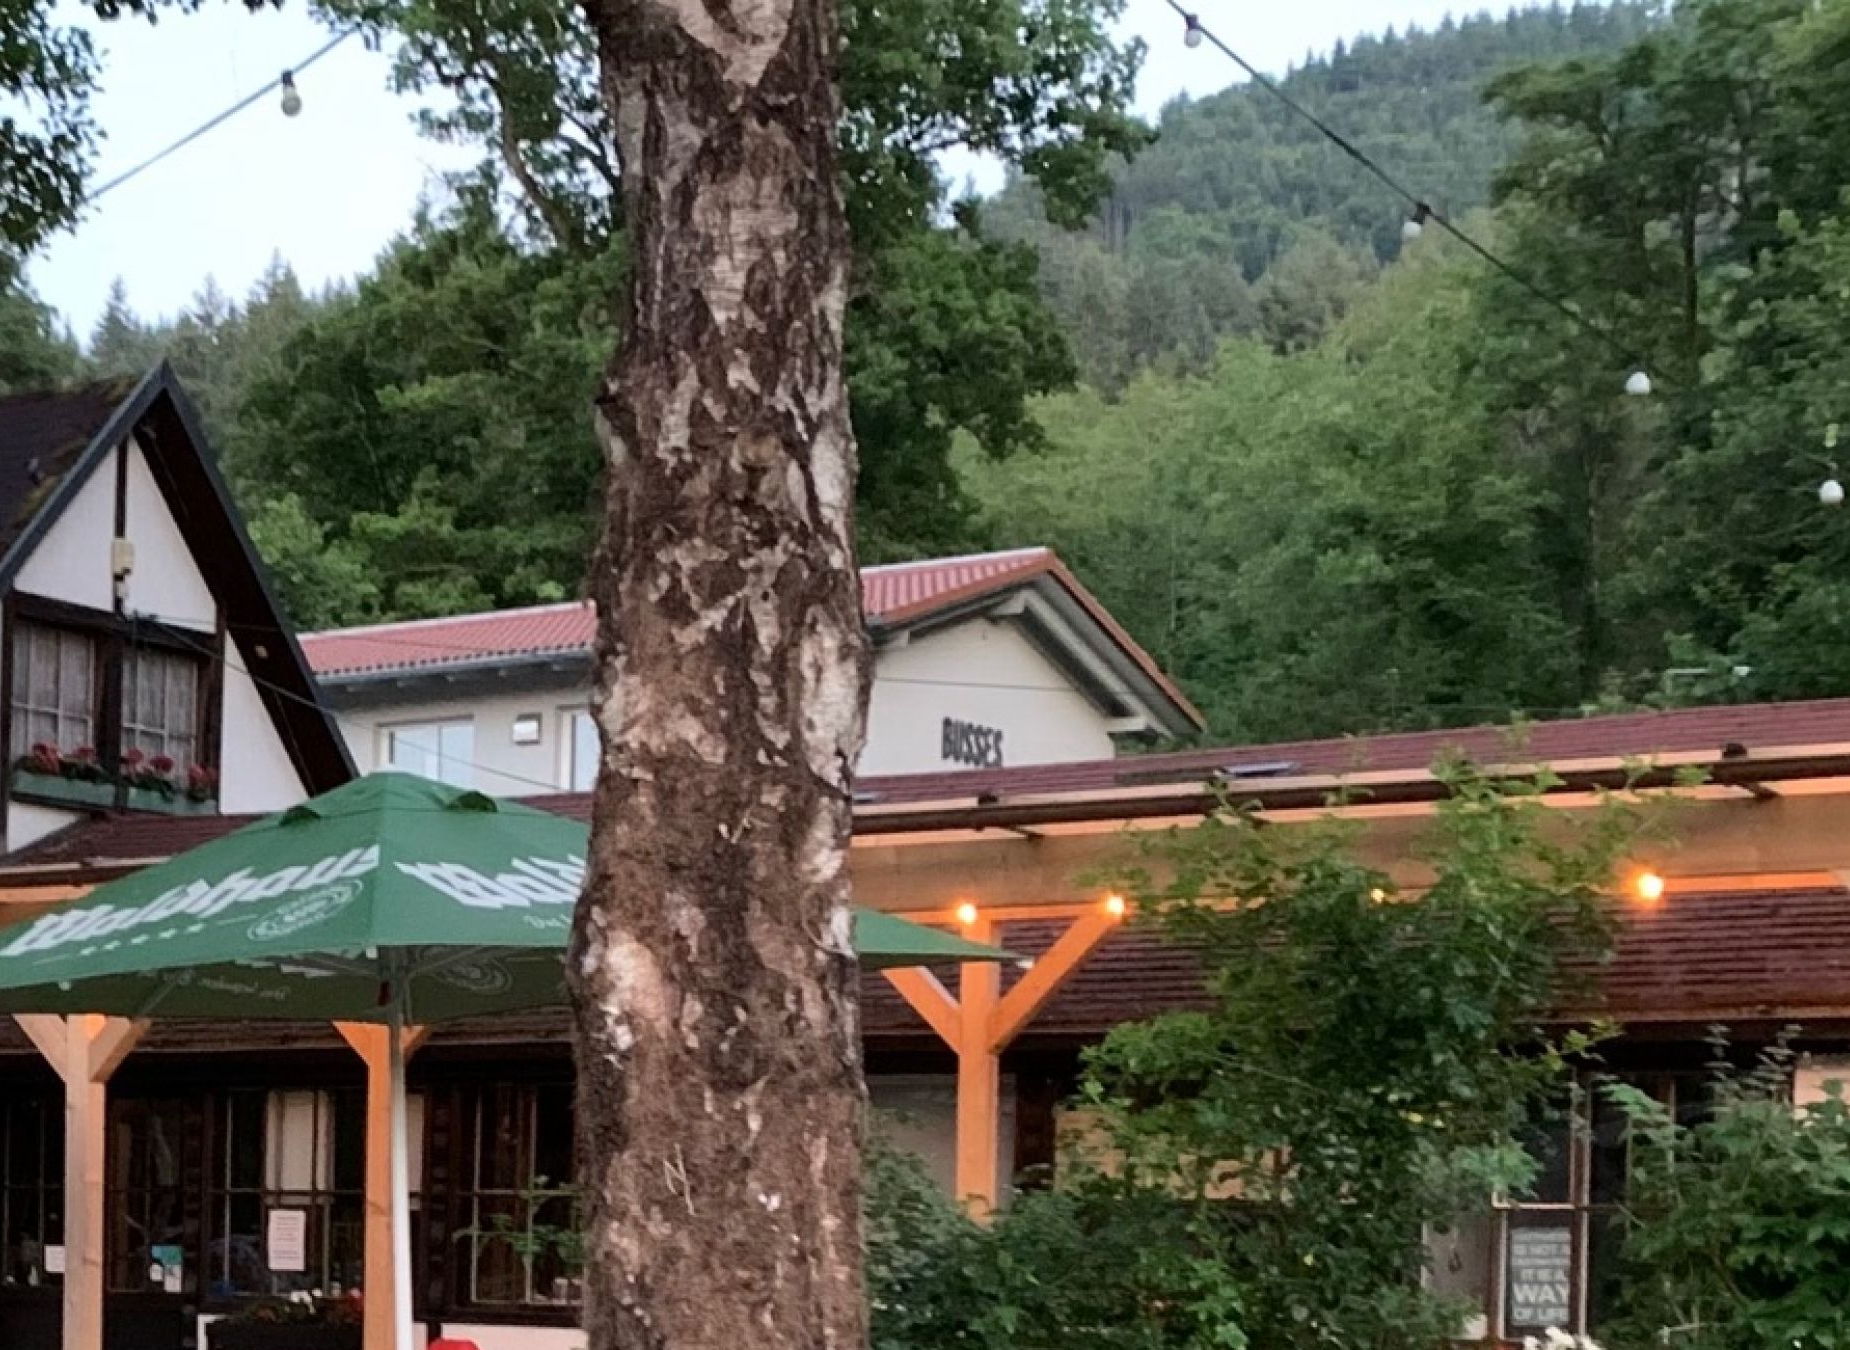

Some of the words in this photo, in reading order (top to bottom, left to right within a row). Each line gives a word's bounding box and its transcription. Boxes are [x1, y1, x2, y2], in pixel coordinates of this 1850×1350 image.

[941, 716, 1004, 768] BUSSES
[393, 854, 586, 910] Wald
[1513, 1283, 1570, 1304] WAY
[1513, 1307, 1533, 1321] OF
[1538, 1307, 1570, 1321] LIFE
